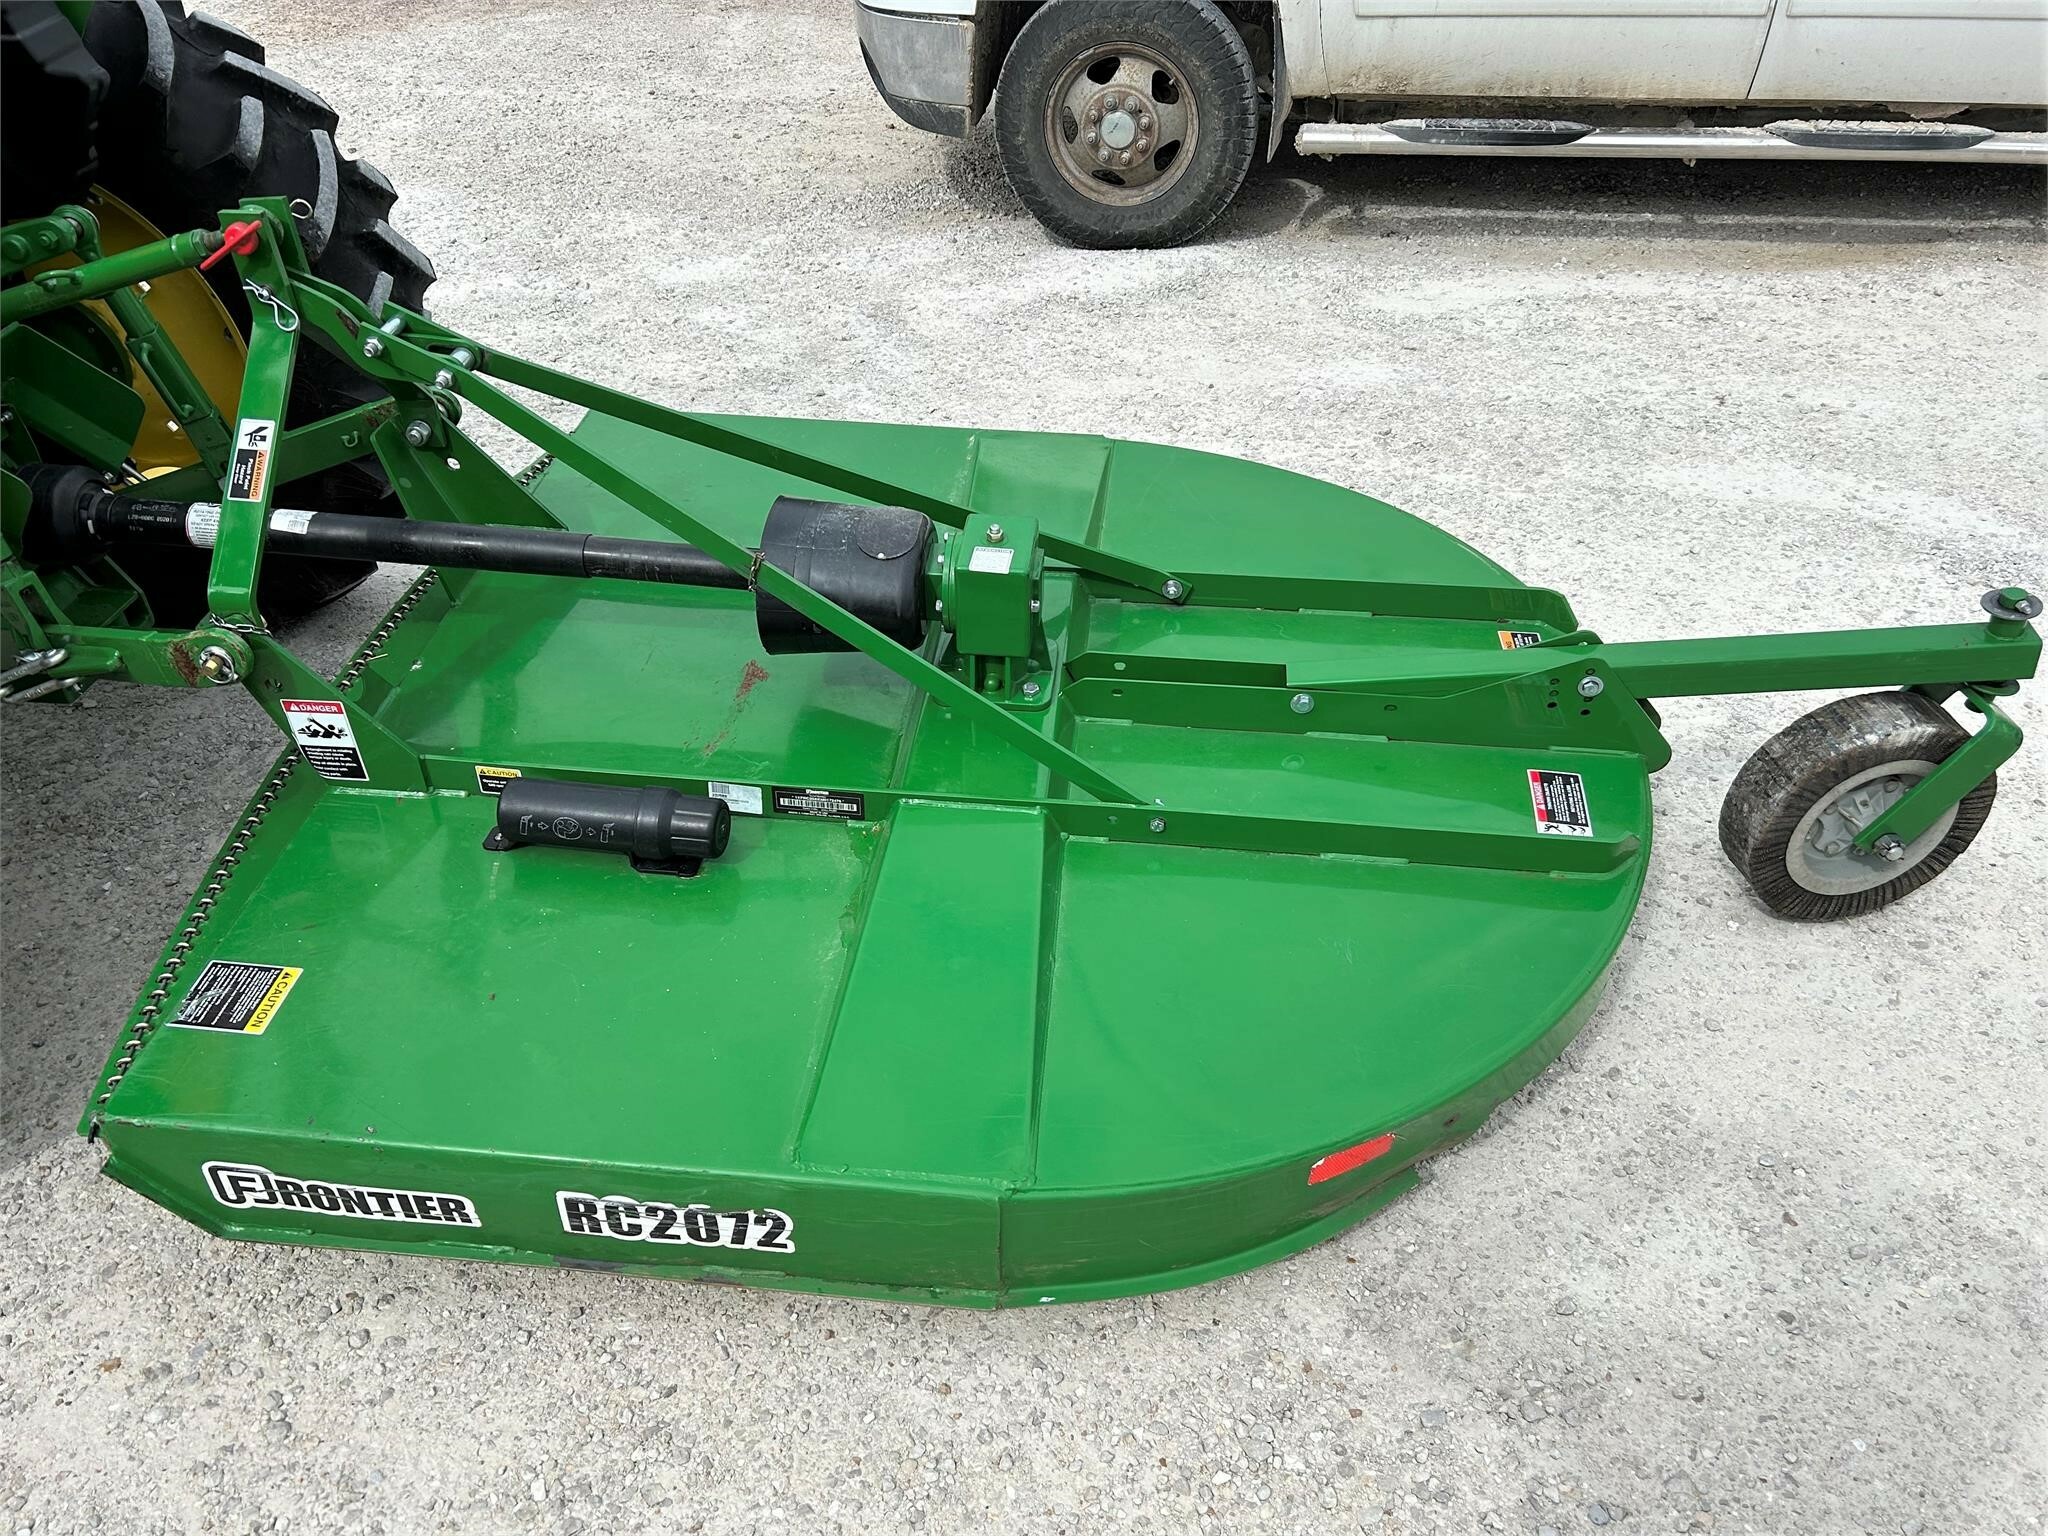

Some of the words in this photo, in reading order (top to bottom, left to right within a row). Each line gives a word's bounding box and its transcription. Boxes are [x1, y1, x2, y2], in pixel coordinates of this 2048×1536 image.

[252, 459, 264, 497] WARNING
[299, 704, 339, 713] DANGER
[486, 770, 518, 778] CAUTION
[251, 981, 288, 1028] CAUTION
[208, 1165, 474, 1224] FRONTIER
[563, 1197, 789, 1250] RC2072
